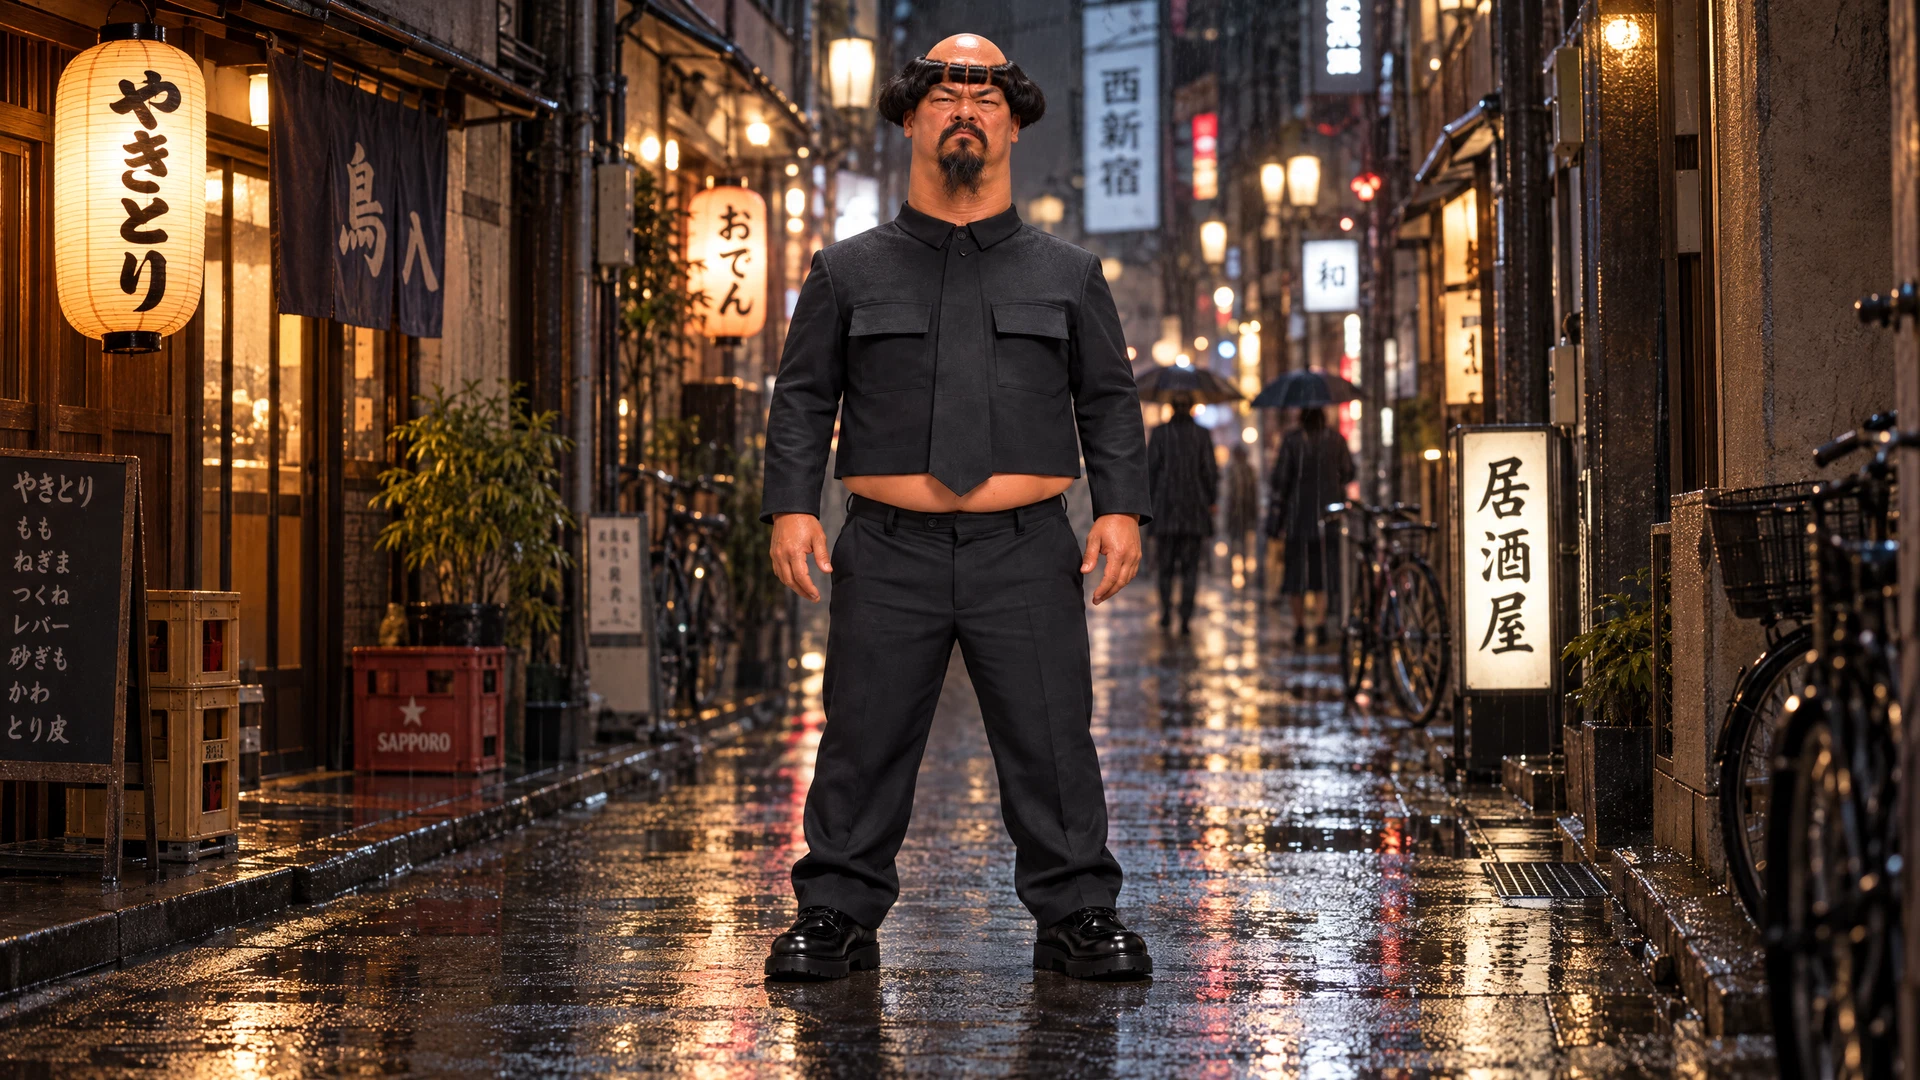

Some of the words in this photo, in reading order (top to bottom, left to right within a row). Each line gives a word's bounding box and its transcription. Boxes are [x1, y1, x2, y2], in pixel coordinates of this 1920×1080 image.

[1100, 66, 1142, 197] 西新宿
[109, 70, 182, 312] やきとり
[719, 205, 753, 316] おでん
[1316, 259, 1346, 291] 和
[13, 471, 93, 508] やきとり
[17, 516, 52, 541] もも
[13, 550, 70, 574] ねぎま
[1477, 456, 1534, 655] 居酒屋
[12, 584, 70, 606] つくね
[13, 614, 70, 635] レバー
[8, 645, 68, 671] 砂ぎも
[8, 681, 50, 704] かわ
[7, 714, 70, 744] とり皮
[377, 732, 451, 753] SAPPORO
